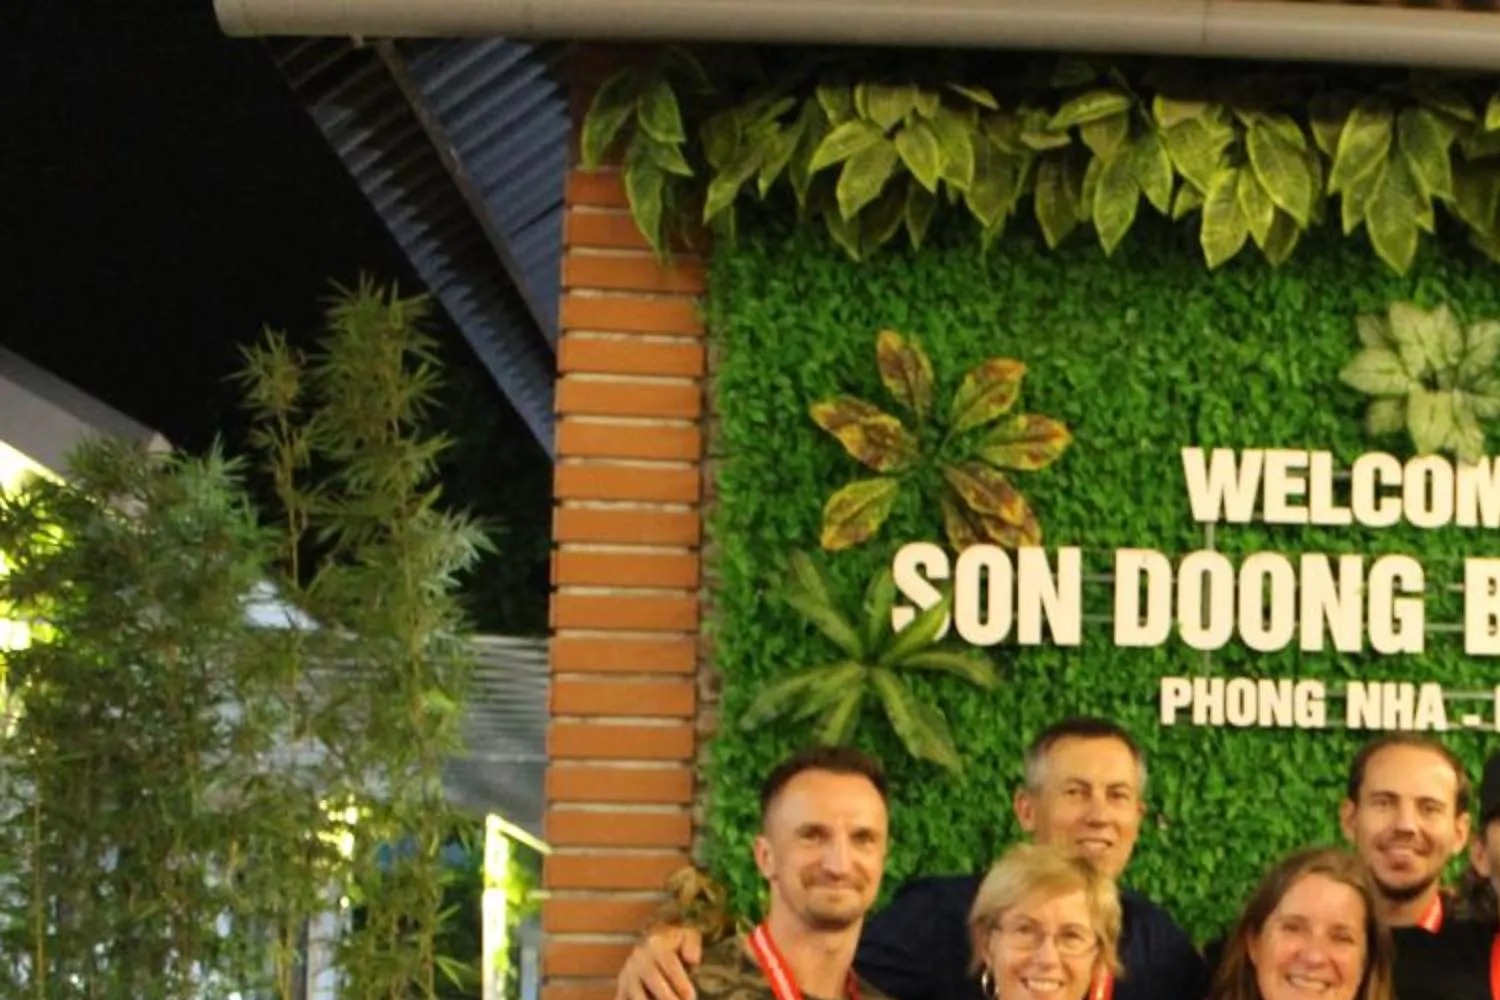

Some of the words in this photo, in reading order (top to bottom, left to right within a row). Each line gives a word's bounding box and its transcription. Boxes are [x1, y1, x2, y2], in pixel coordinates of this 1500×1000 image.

[892, 542, 1082, 645] SON
[1114, 548, 1425, 655] DOONG
[1160, 677, 1326, 728] PHONG
[1346, 682, 1450, 732] NHA
